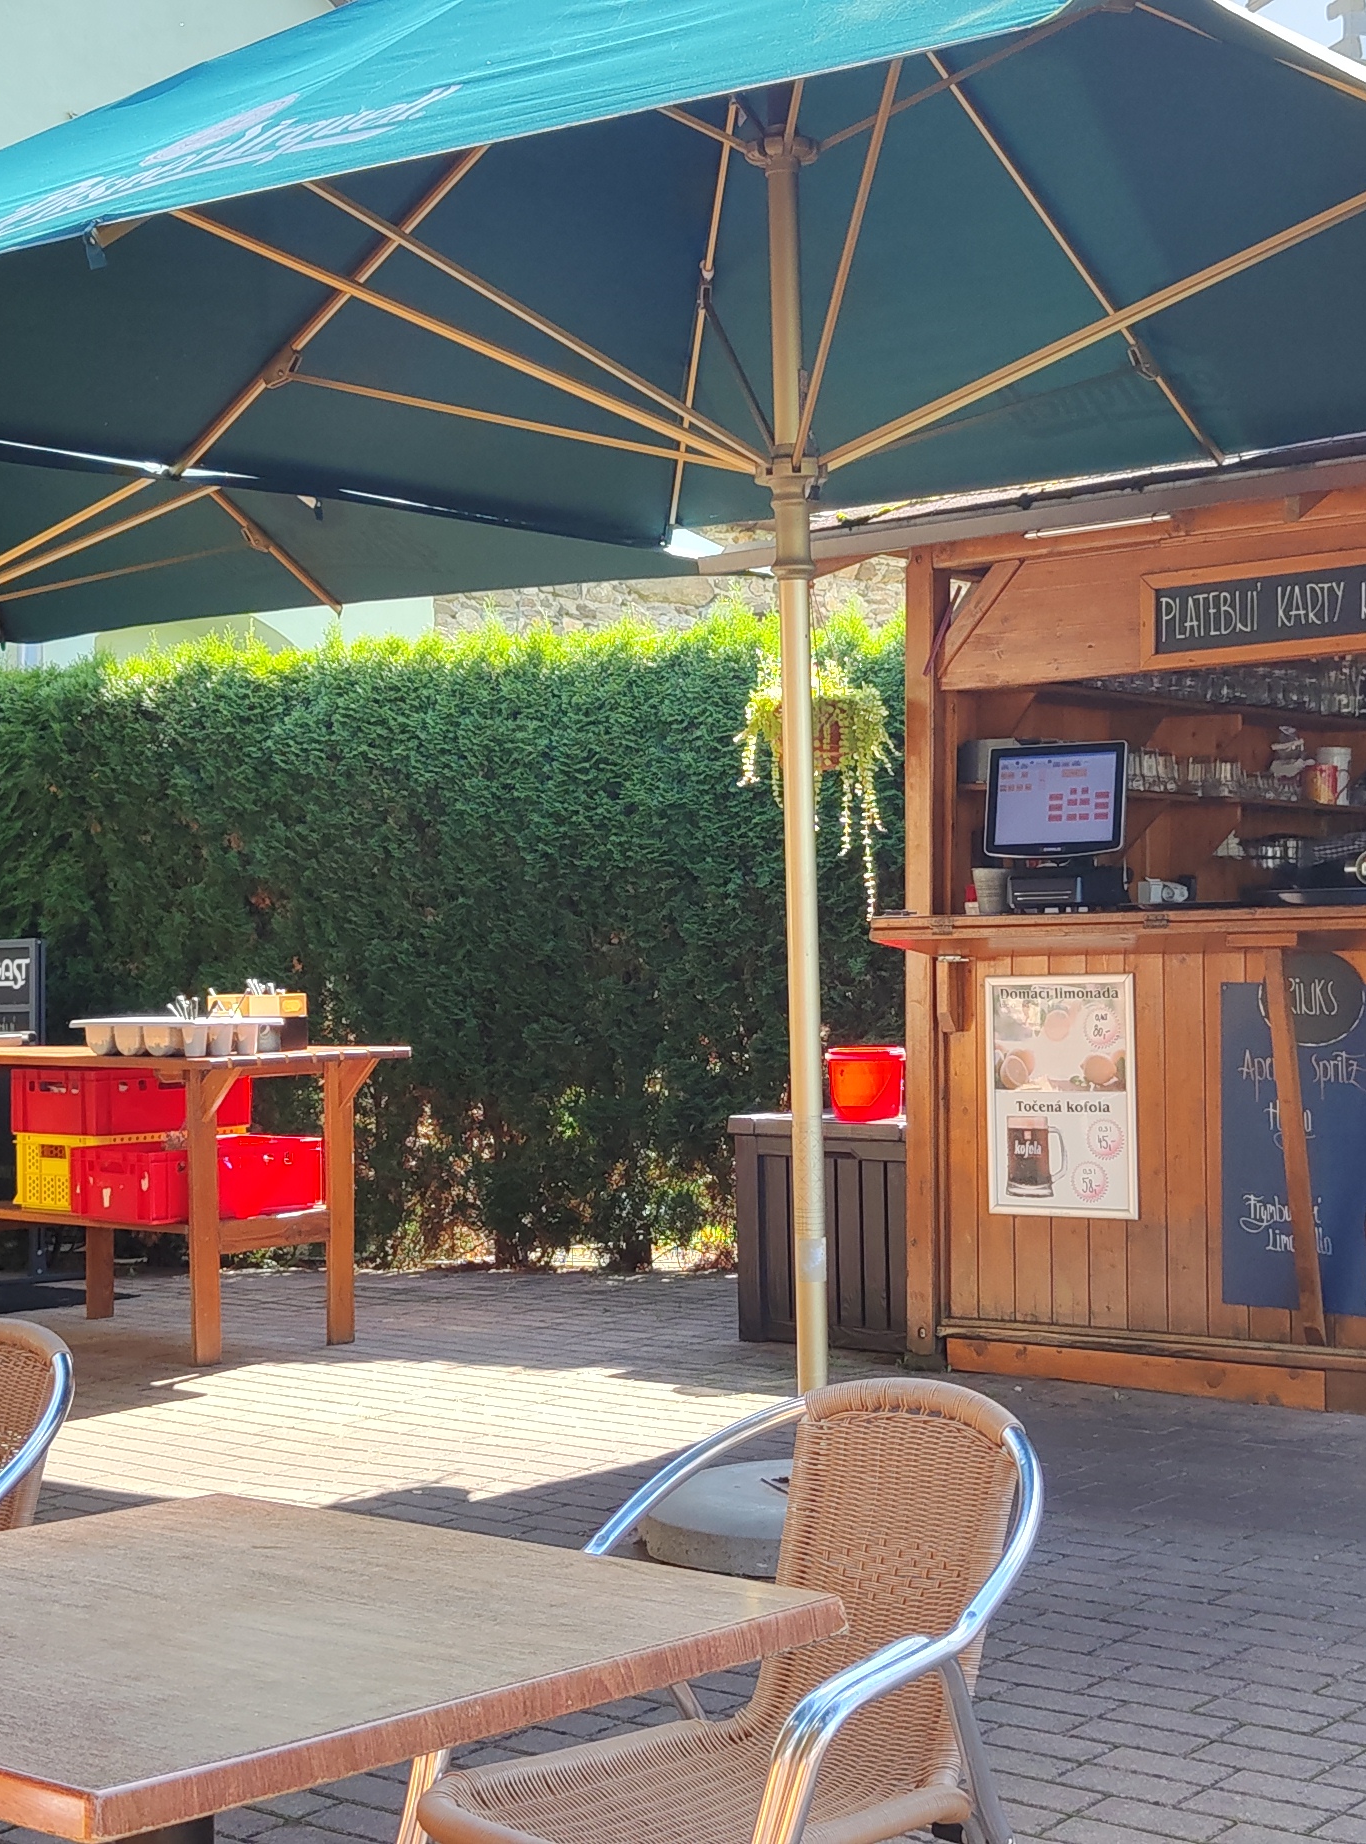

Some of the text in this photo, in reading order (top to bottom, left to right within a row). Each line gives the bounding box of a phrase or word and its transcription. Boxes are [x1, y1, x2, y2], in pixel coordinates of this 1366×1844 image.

[1160, 582, 1262, 643] PLATEBNÍ
[1277, 581, 1345, 628] KARTY
[1237, 1049, 1276, 1102] Ape
[1015, 1100, 1111, 1113] Točená kofola
[1014, 1140, 1041, 1158] kofola
[1266, 1227, 1333, 1255] Limllo
